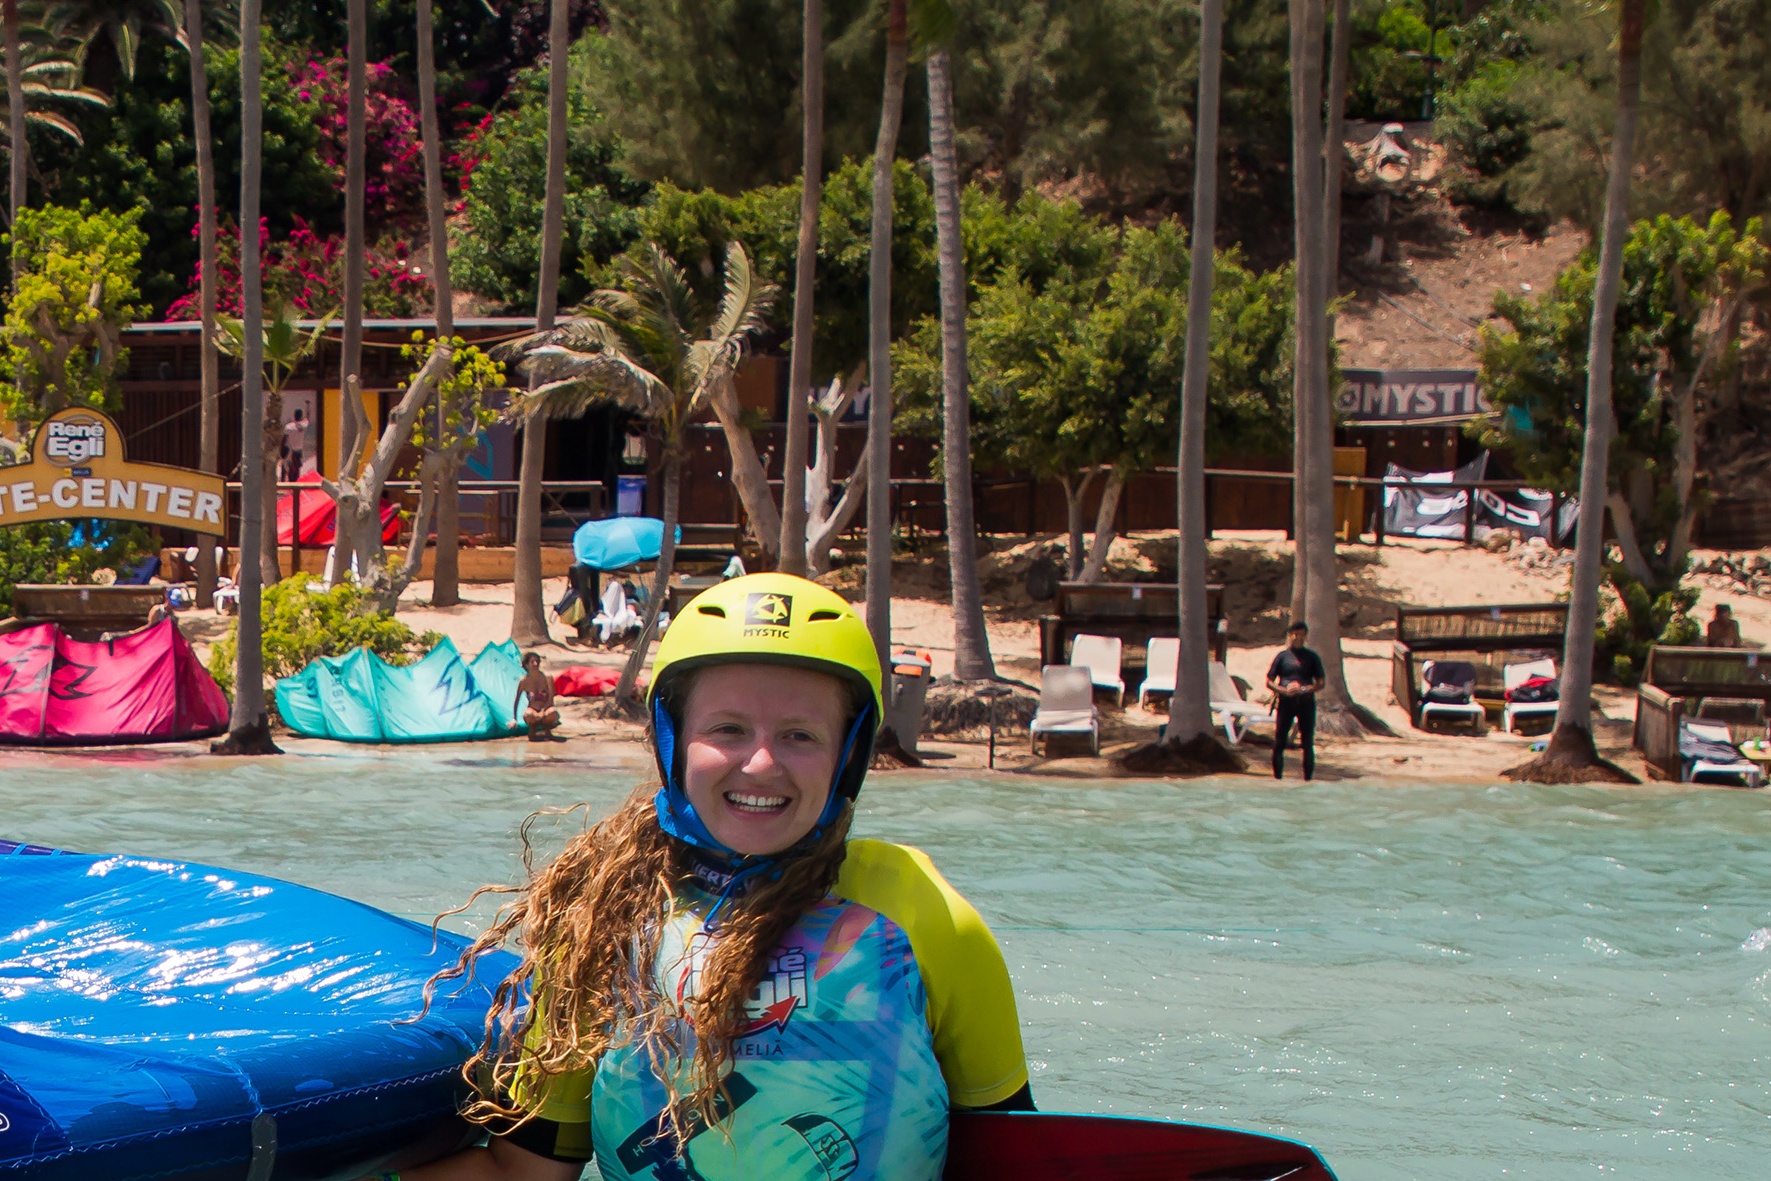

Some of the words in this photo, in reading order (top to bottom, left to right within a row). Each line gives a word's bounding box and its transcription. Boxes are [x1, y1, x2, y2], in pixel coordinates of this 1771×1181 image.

[48, 421, 105, 437] René
[47, 436, 105, 462] Egli
[743, 628, 790, 639] MYSTIC
